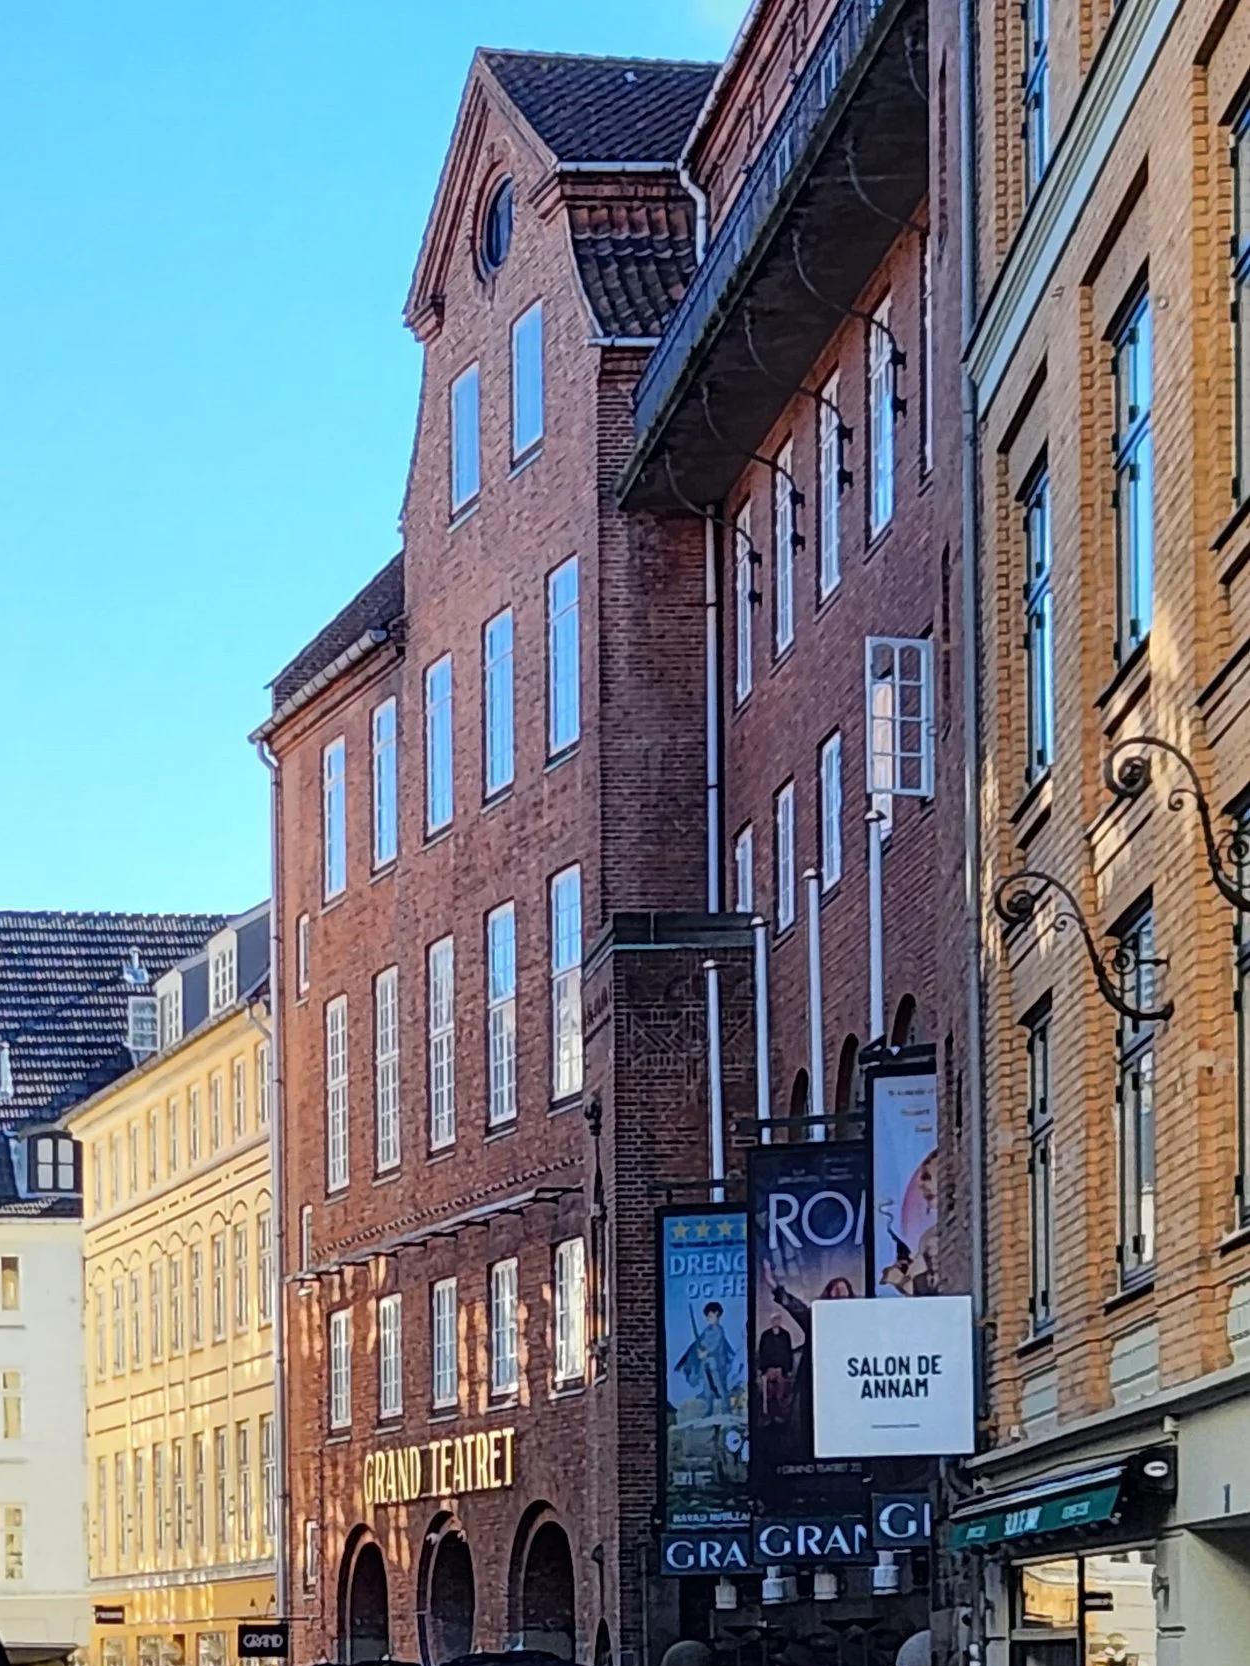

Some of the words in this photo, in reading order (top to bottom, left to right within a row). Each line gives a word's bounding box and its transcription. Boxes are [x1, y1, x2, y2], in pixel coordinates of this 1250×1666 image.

[768, 1187, 867, 1250] RO
[720, 1274, 747, 1297] HE
[846, 1356, 911, 1378] SALON
[917, 1354, 942, 1376] DE
[860, 1378, 929, 1399] ANNAM
[364, 1445, 422, 1505] GRAND
[428, 1427, 516, 1497] TEATRET
[666, 1540, 748, 1569] GRA
